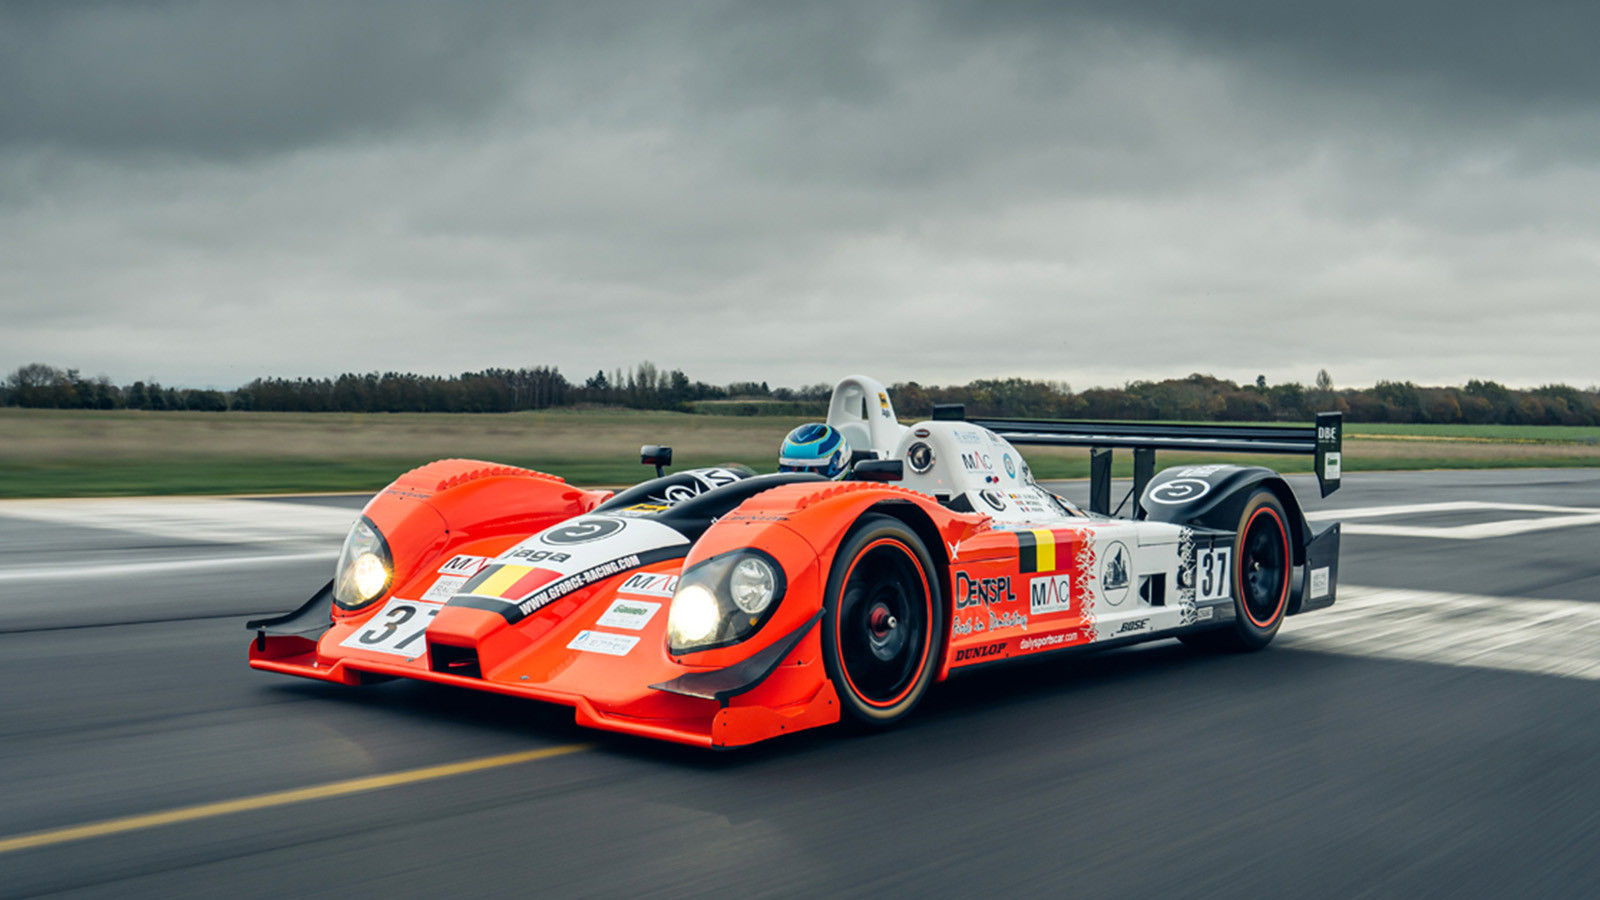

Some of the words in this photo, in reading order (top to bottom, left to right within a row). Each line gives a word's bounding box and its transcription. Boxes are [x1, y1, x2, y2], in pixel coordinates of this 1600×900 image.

[1318, 426, 1336, 440] DBE
[961, 450, 993, 470] MAC
[445, 556, 488, 571] MA
[501, 546, 572, 563] jaga
[1202, 552, 1227, 597] 37
[518, 554, 641, 616] WWW.GFORCE-RACING.COM
[1031, 576, 1069, 607] MAC
[1116, 617, 1150, 634] BOSE
[1020, 632, 1078, 651] dailysportscar.com
[955, 642, 1008, 662] DUNLOP
